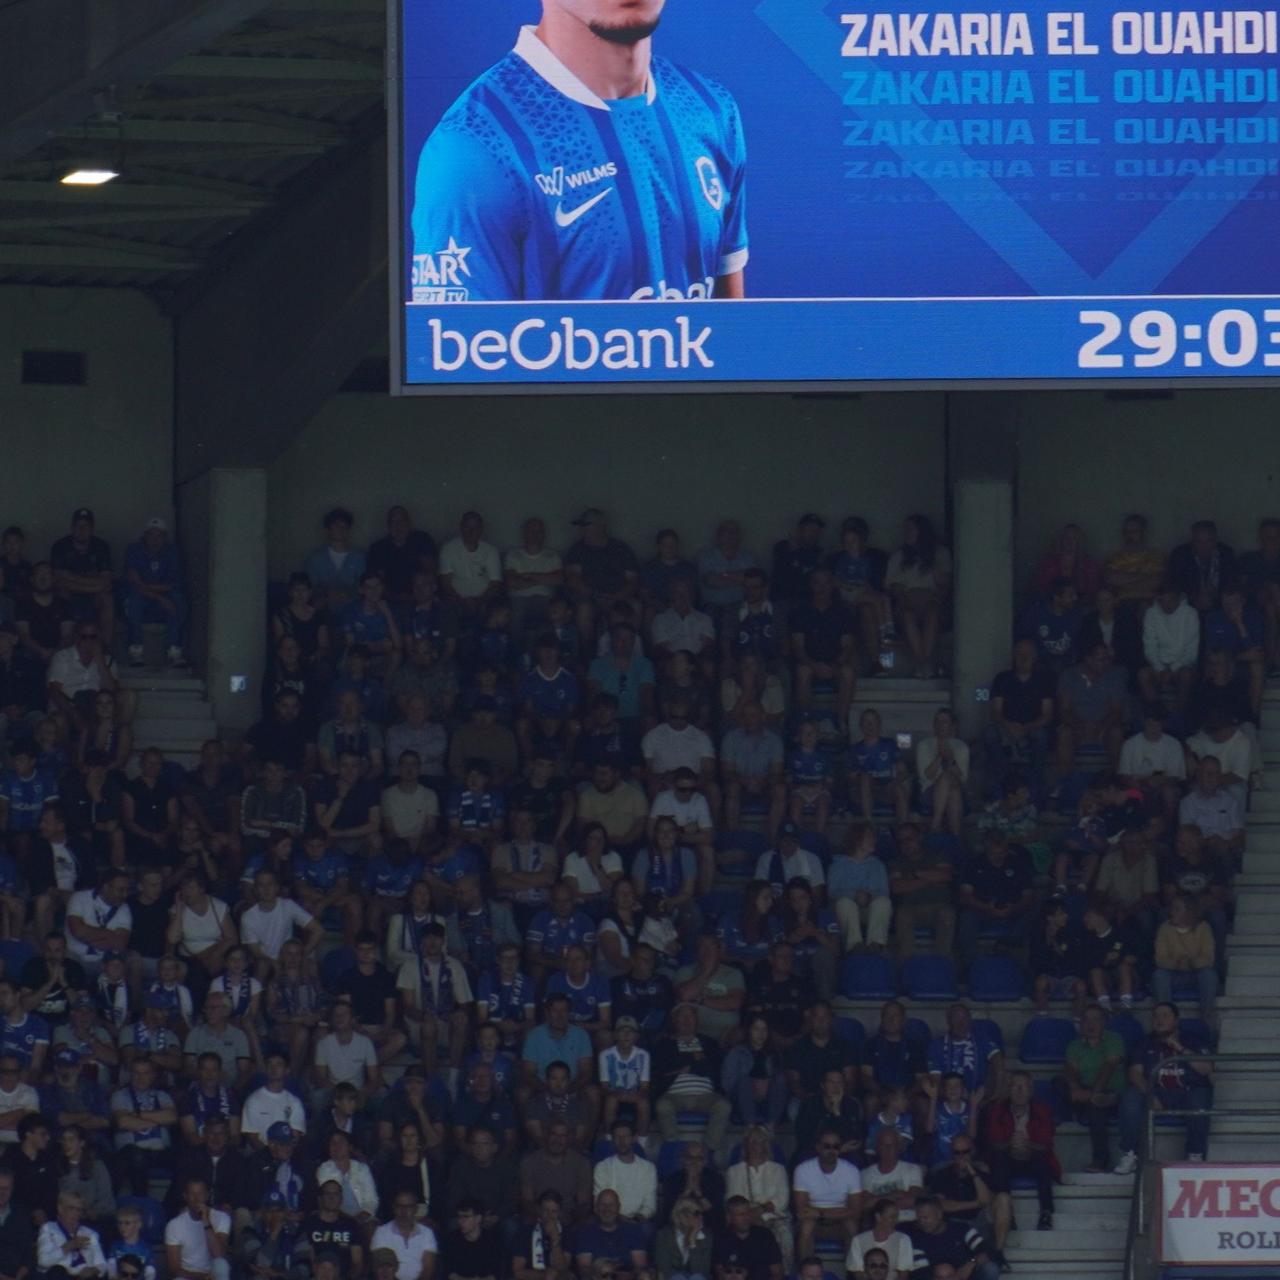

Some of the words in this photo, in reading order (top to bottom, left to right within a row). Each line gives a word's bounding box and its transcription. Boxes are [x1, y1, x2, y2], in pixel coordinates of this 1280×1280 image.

[841, 13, 1034, 57] ZAKARIA
[1047, 12, 1099, 56] EL
[1112, 11, 1278, 55] OUAHDI
[842, 70, 1034, 105] ZAKARIA
[1049, 69, 1100, 104] EL
[1114, 68, 1278, 103] OUAHDI
[843, 119, 1035, 146] ZAKARIA
[1049, 119, 1100, 145] EL
[1114, 117, 1278, 144] OUAHDI
[565, 162, 618, 189] WILMS
[844, 160, 1035, 179] ZAKARIA
[1049, 159, 1100, 177] EL
[1115, 158, 1279, 177] OUAHDI
